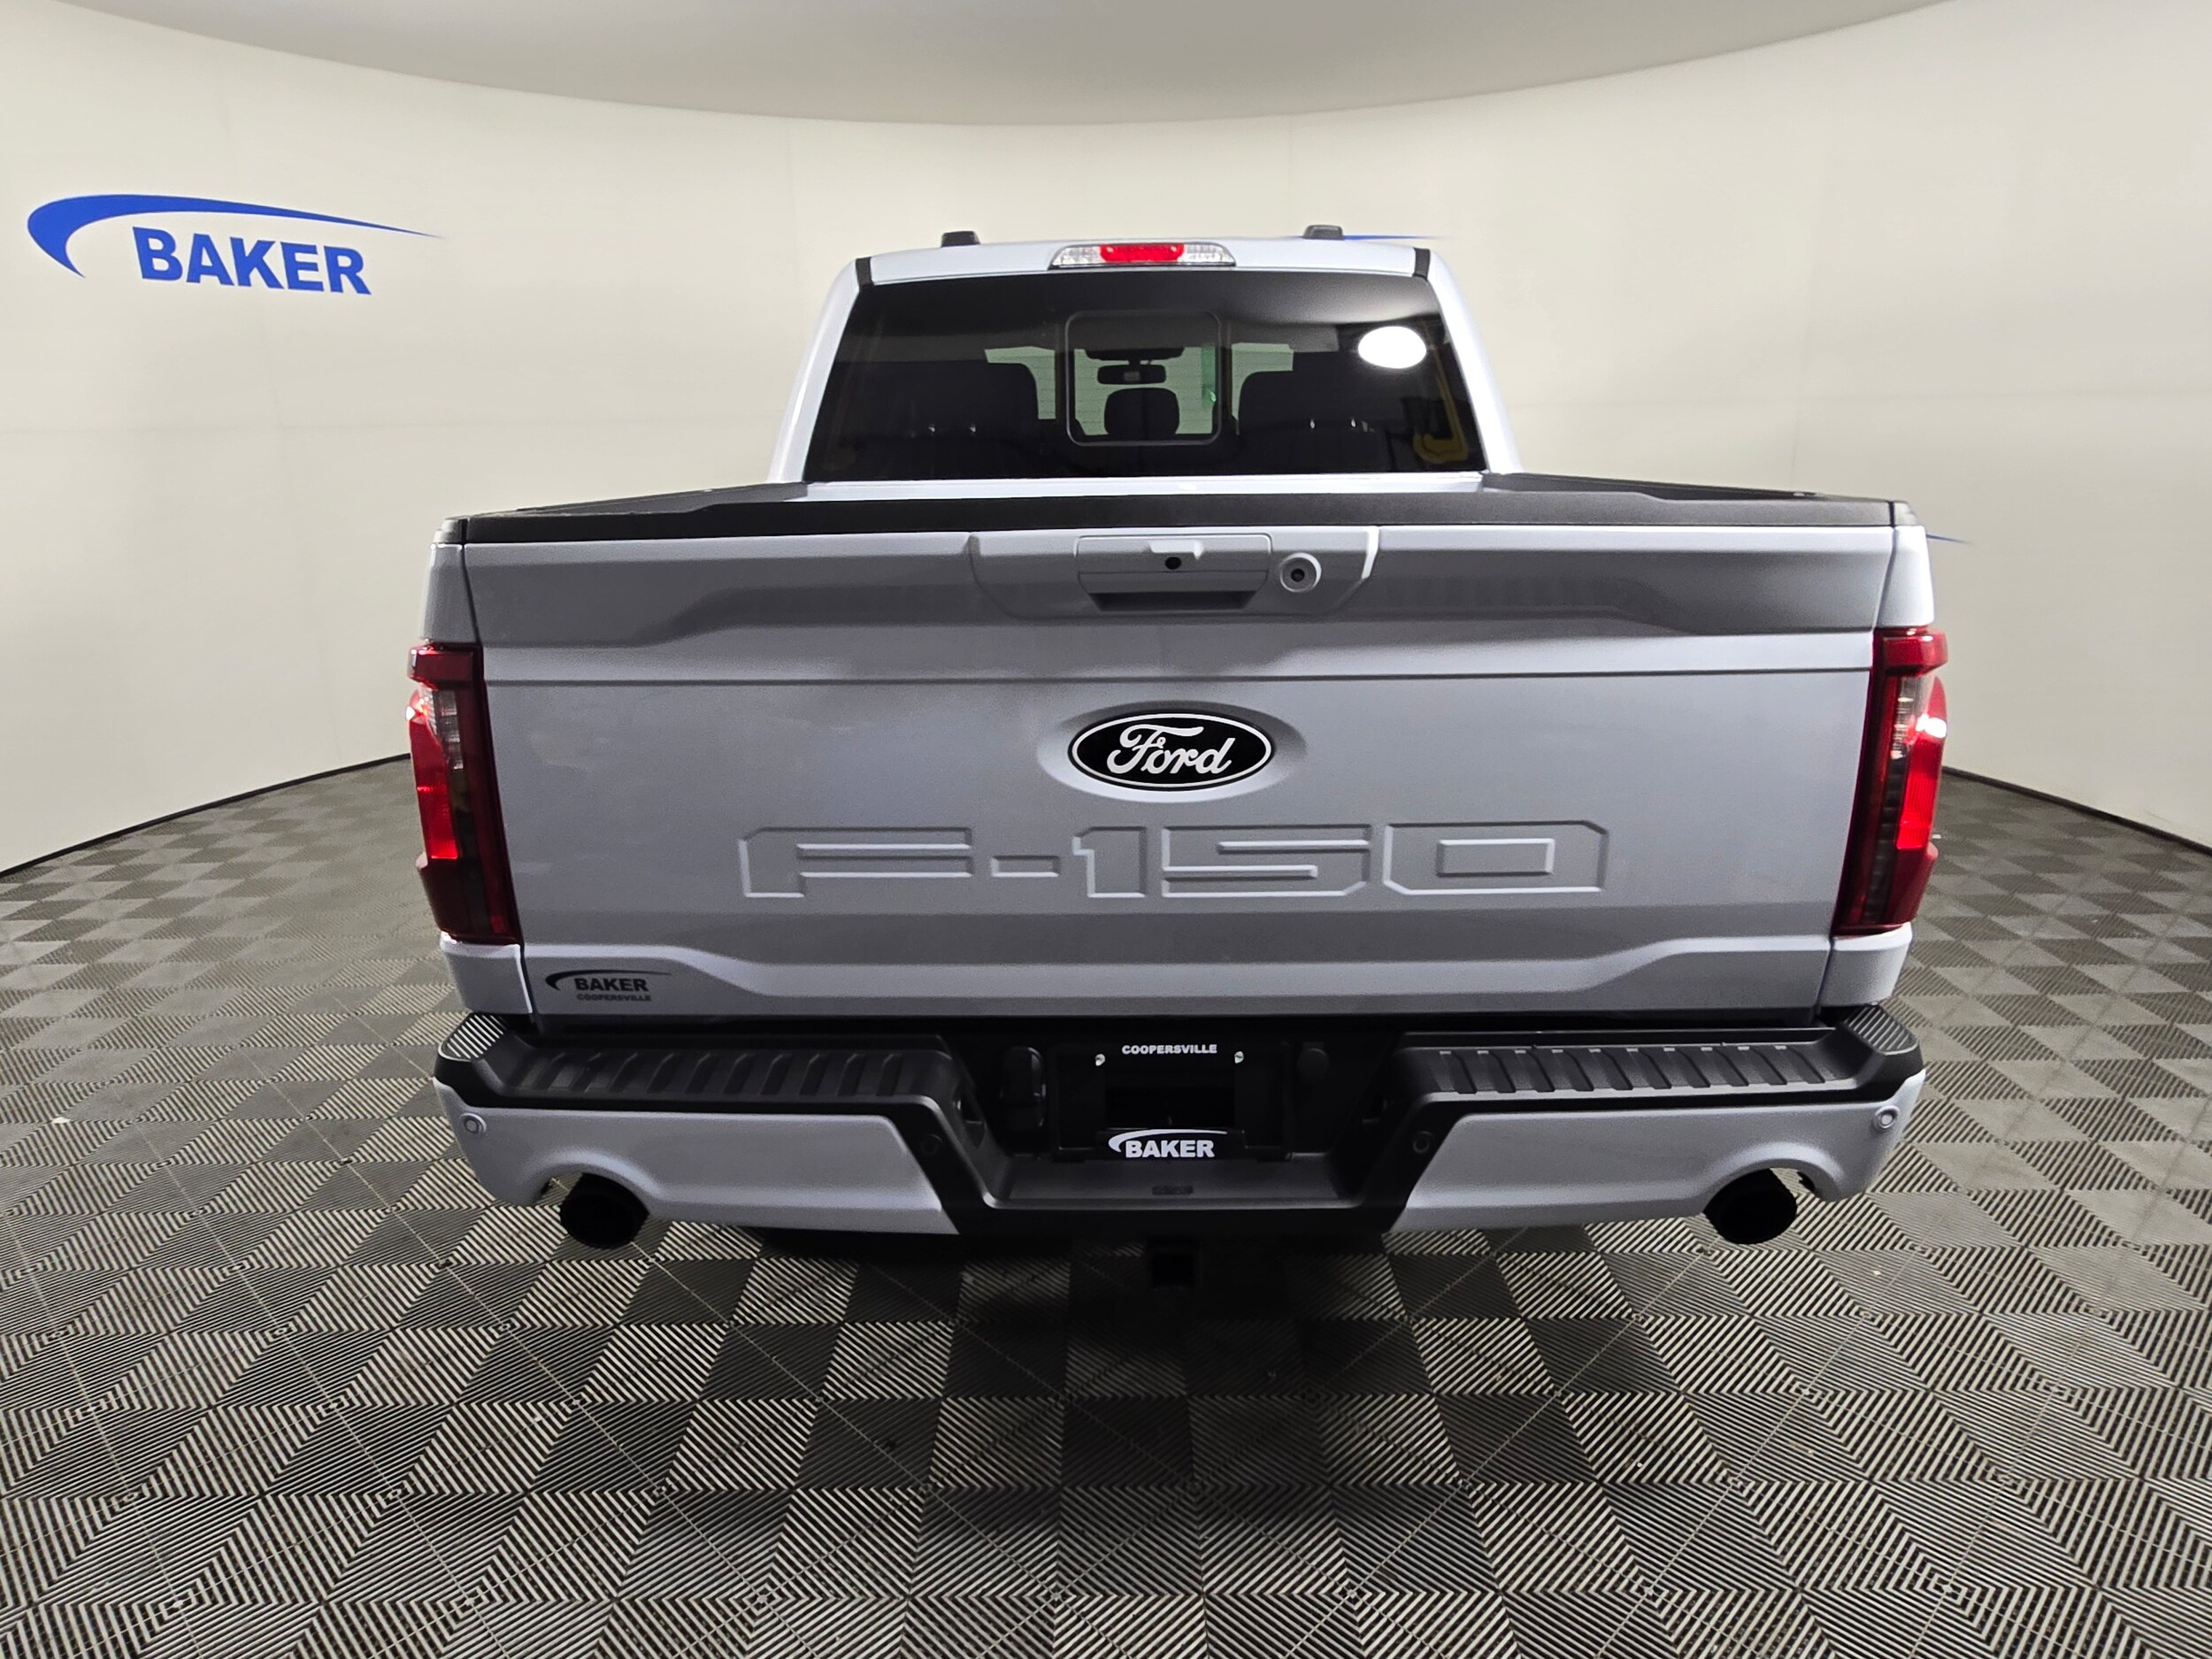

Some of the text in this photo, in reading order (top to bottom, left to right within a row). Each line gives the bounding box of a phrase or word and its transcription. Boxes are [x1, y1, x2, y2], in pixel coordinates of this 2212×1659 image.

[132, 227, 372, 295] BAKER
[1107, 724, 1236, 774] Ford
[739, 821, 1609, 898] F-150
[574, 978, 649, 992] BAKER
[1122, 1044, 1217, 1055] COOPERSVILLE
[1125, 1140, 1215, 1158] BAKER
